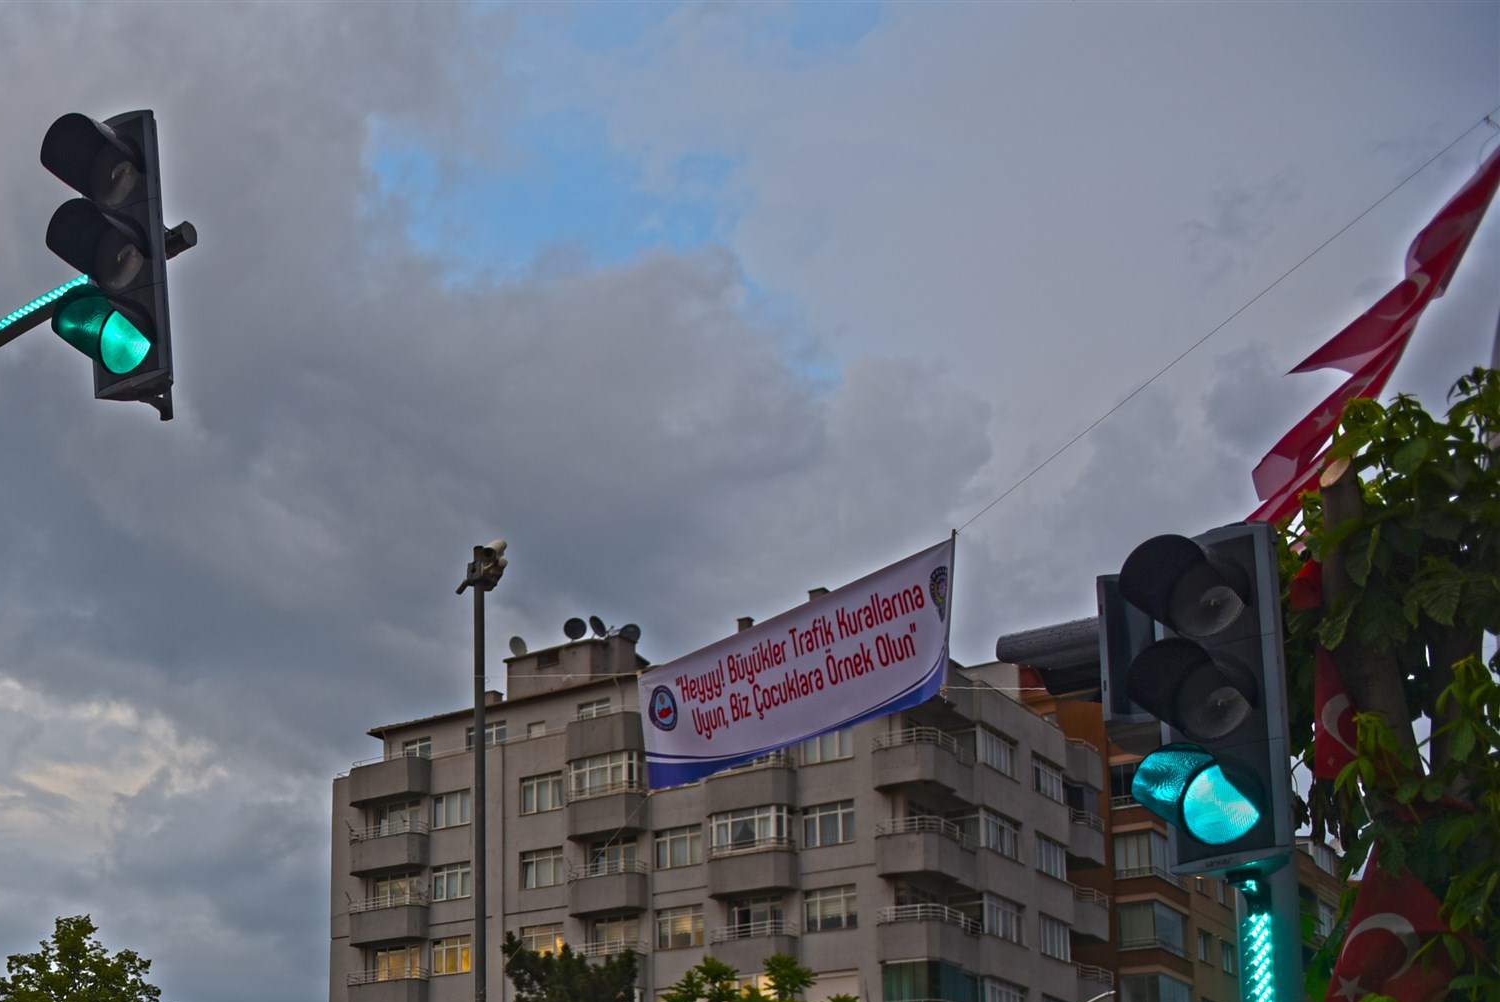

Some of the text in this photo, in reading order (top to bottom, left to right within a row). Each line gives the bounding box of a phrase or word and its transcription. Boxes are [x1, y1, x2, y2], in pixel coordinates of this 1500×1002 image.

[691, 706, 729, 741] Uyun,
[730, 694, 752, 722] Biz
[753, 668, 825, 721] Çocuklara
[825, 645, 876, 686] Örnek
[879, 623, 918, 668] Olun"
[728, 639, 787, 687] Büyükler
[788, 616, 835, 659] Trafik
[836, 584, 925, 641] Kurallarına
